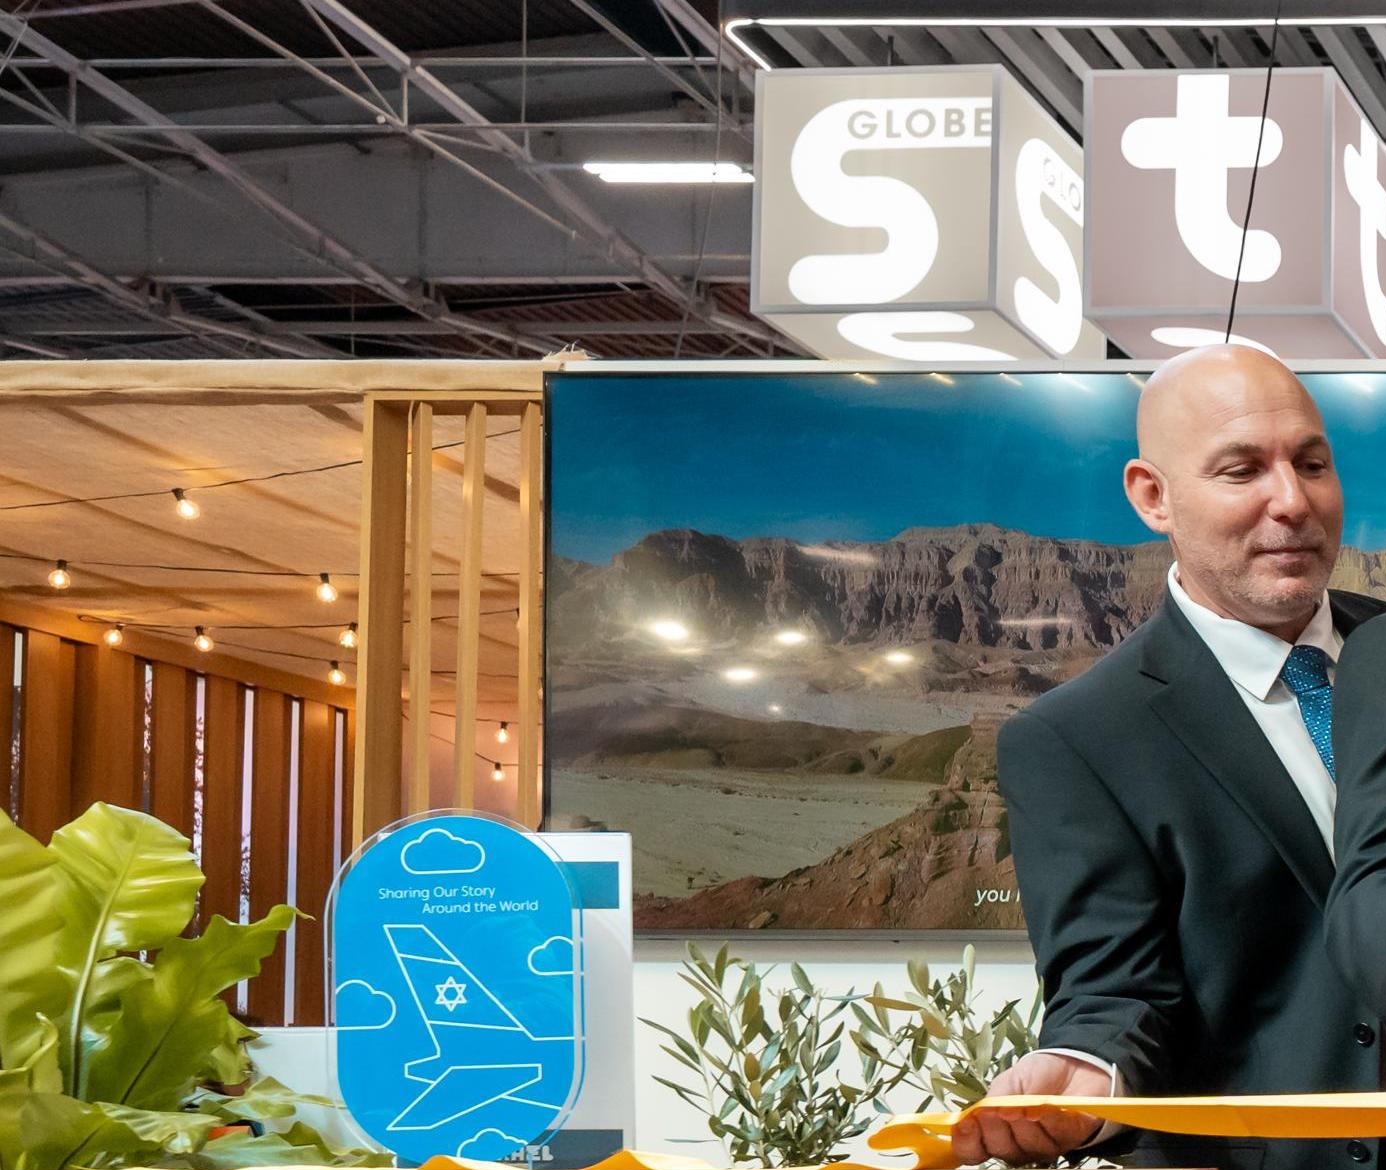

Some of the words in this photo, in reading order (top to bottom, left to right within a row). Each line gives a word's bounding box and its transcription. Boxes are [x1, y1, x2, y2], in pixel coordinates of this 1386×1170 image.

[847, 107, 992, 140] GLOBE
[378, 887, 430, 901] Sharing
[433, 886, 459, 898] Our
[461, 885, 496, 899] Story
[974, 889, 1011, 907] you
[422, 902, 471, 914] Around
[474, 901, 497, 912] the
[499, 900, 539, 912] World
